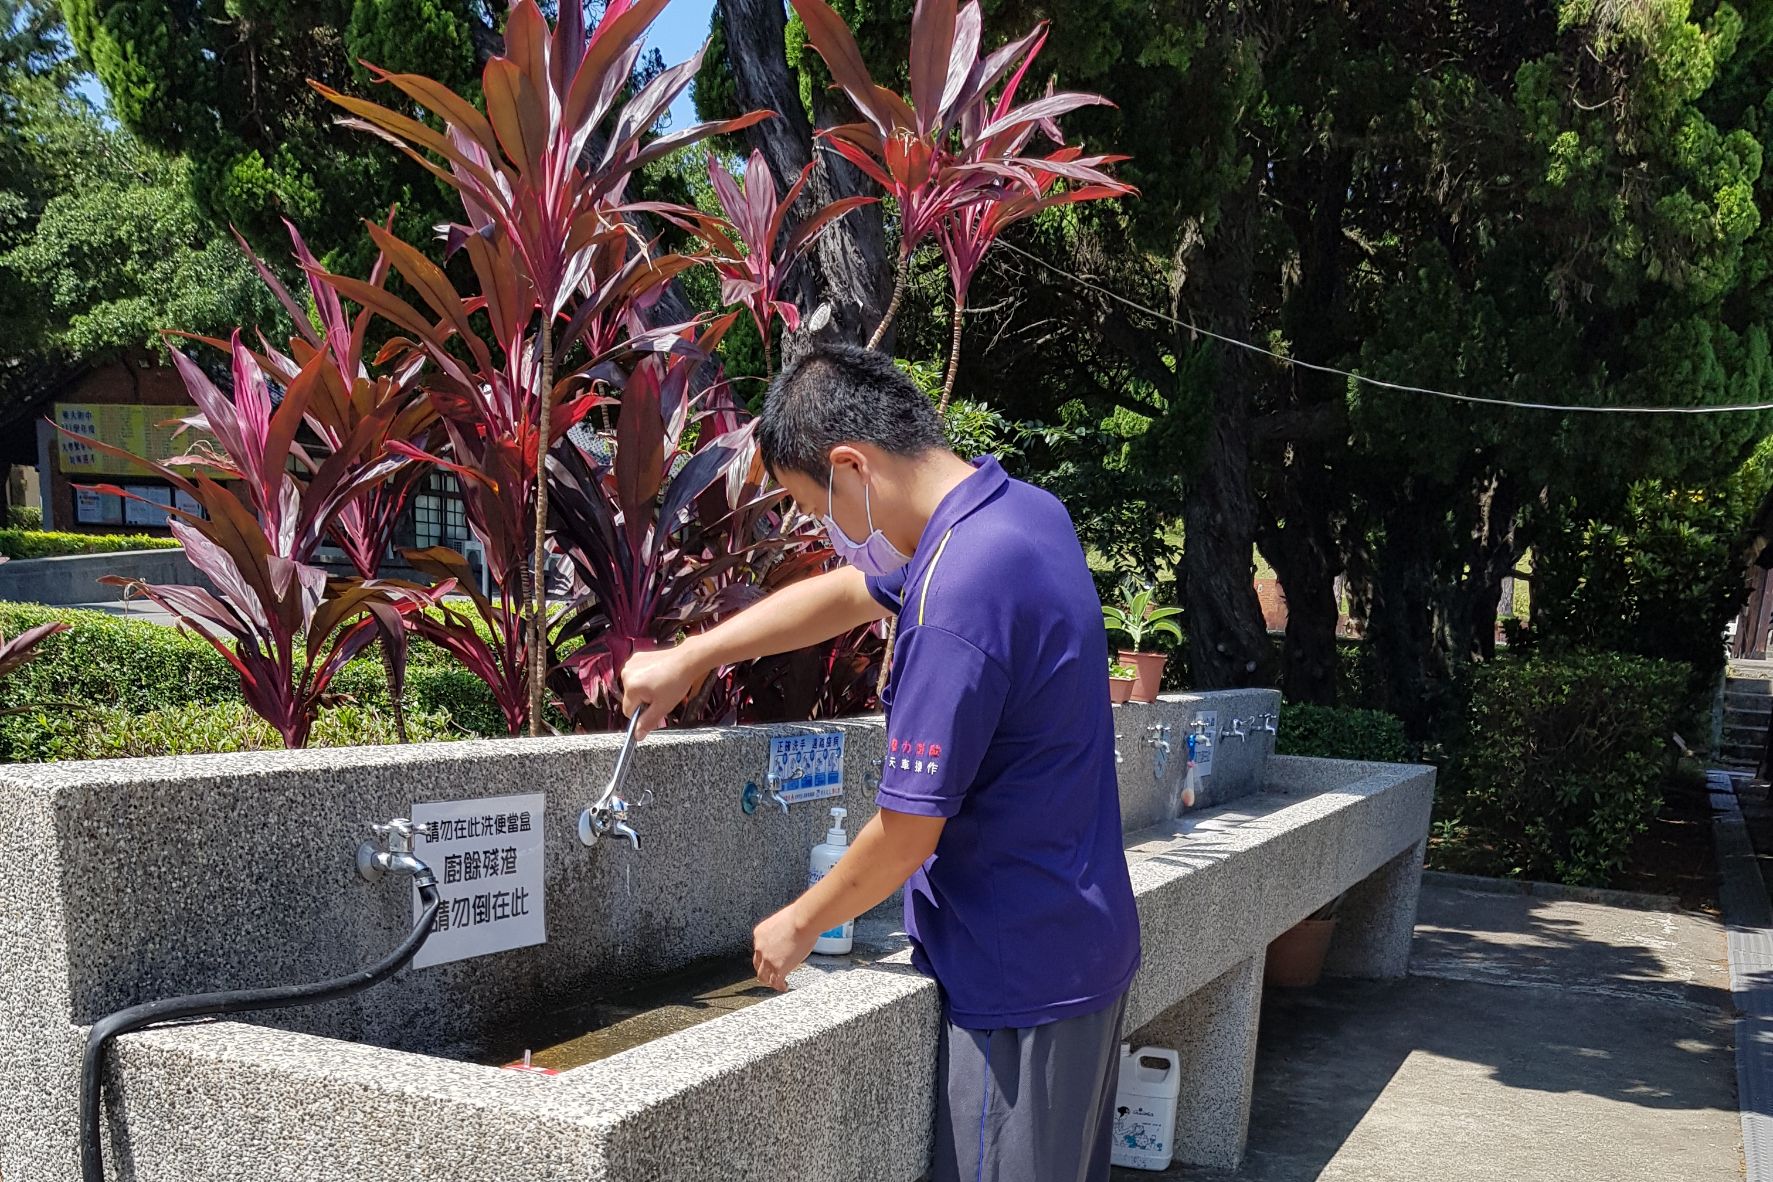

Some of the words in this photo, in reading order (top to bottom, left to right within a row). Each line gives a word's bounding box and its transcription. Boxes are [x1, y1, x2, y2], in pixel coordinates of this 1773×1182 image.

[888, 756, 939, 775] 天車操作
[425, 811, 532, 843] 請勿在此洗便當盒
[443, 846, 518, 885] 廚餘殘渣
